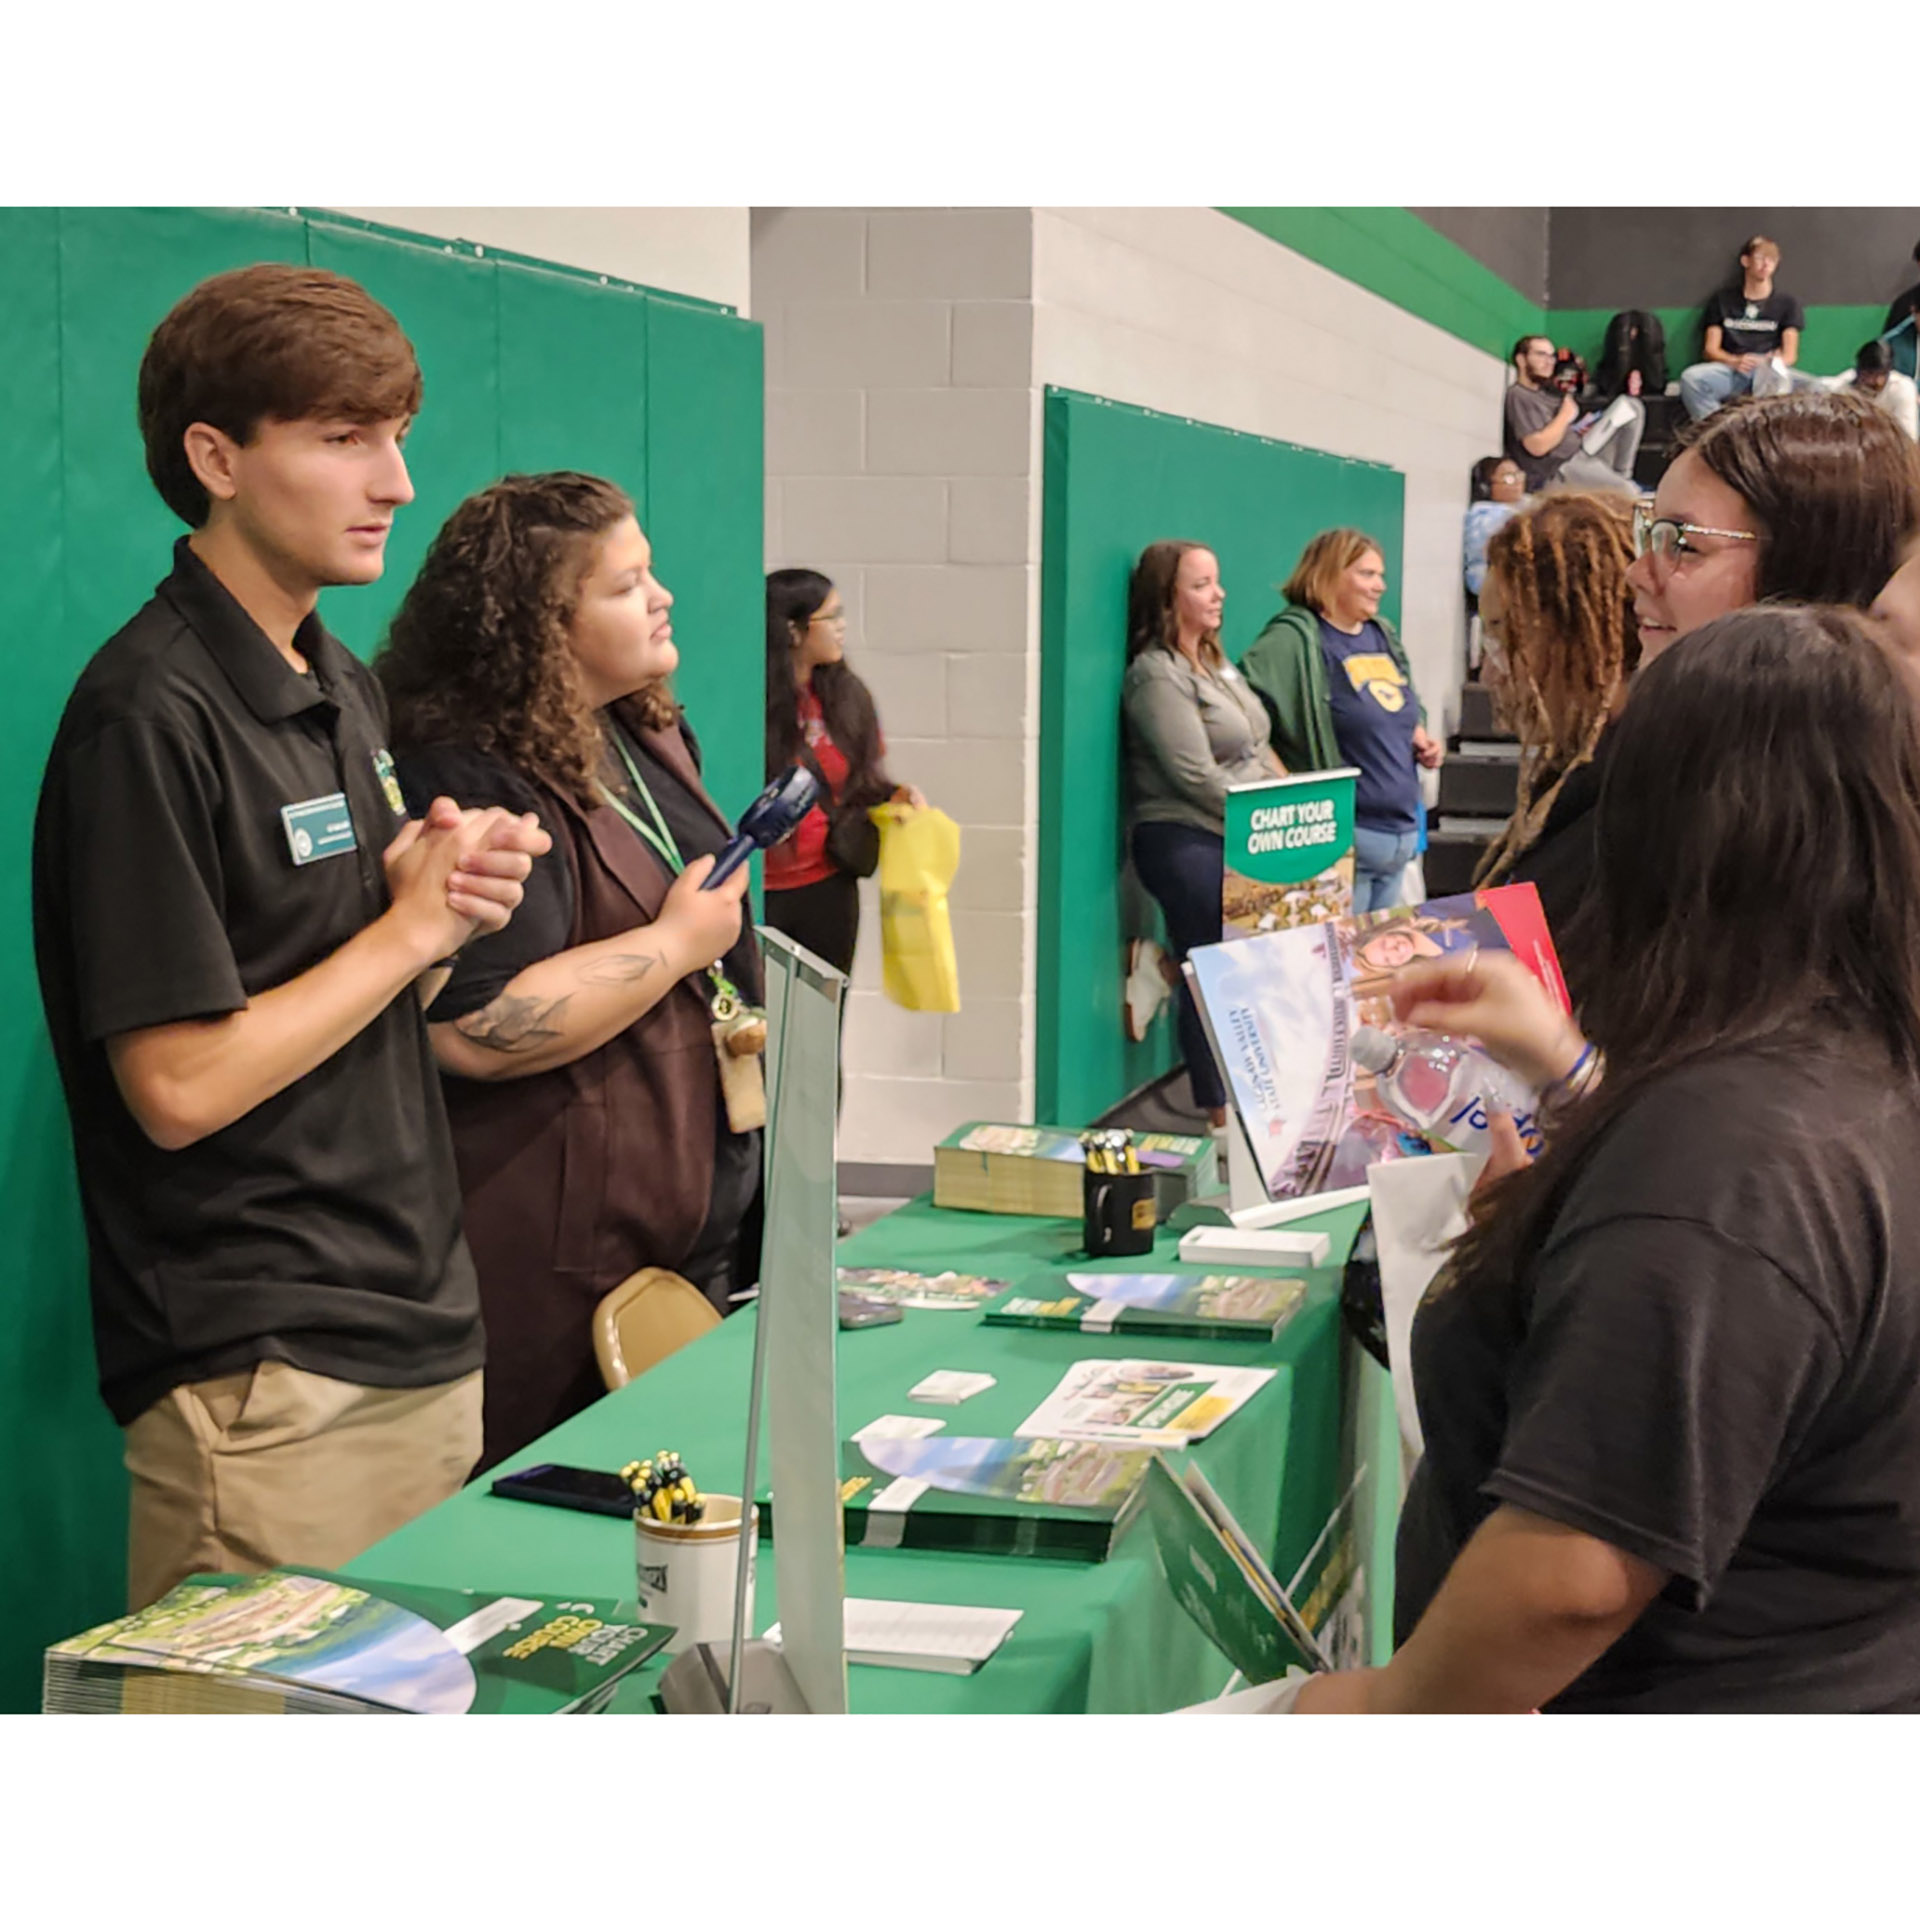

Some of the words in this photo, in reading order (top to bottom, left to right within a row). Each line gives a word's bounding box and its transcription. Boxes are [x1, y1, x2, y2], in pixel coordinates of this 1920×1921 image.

[1250, 804, 1296, 831] CHART
[1297, 798, 1335, 823] YOUR
[1247, 829, 1284, 856] OWN
[1285, 820, 1337, 849] COURSE
[567, 1623, 630, 1656] YOUR
[585, 1626, 648, 1666] CHART
